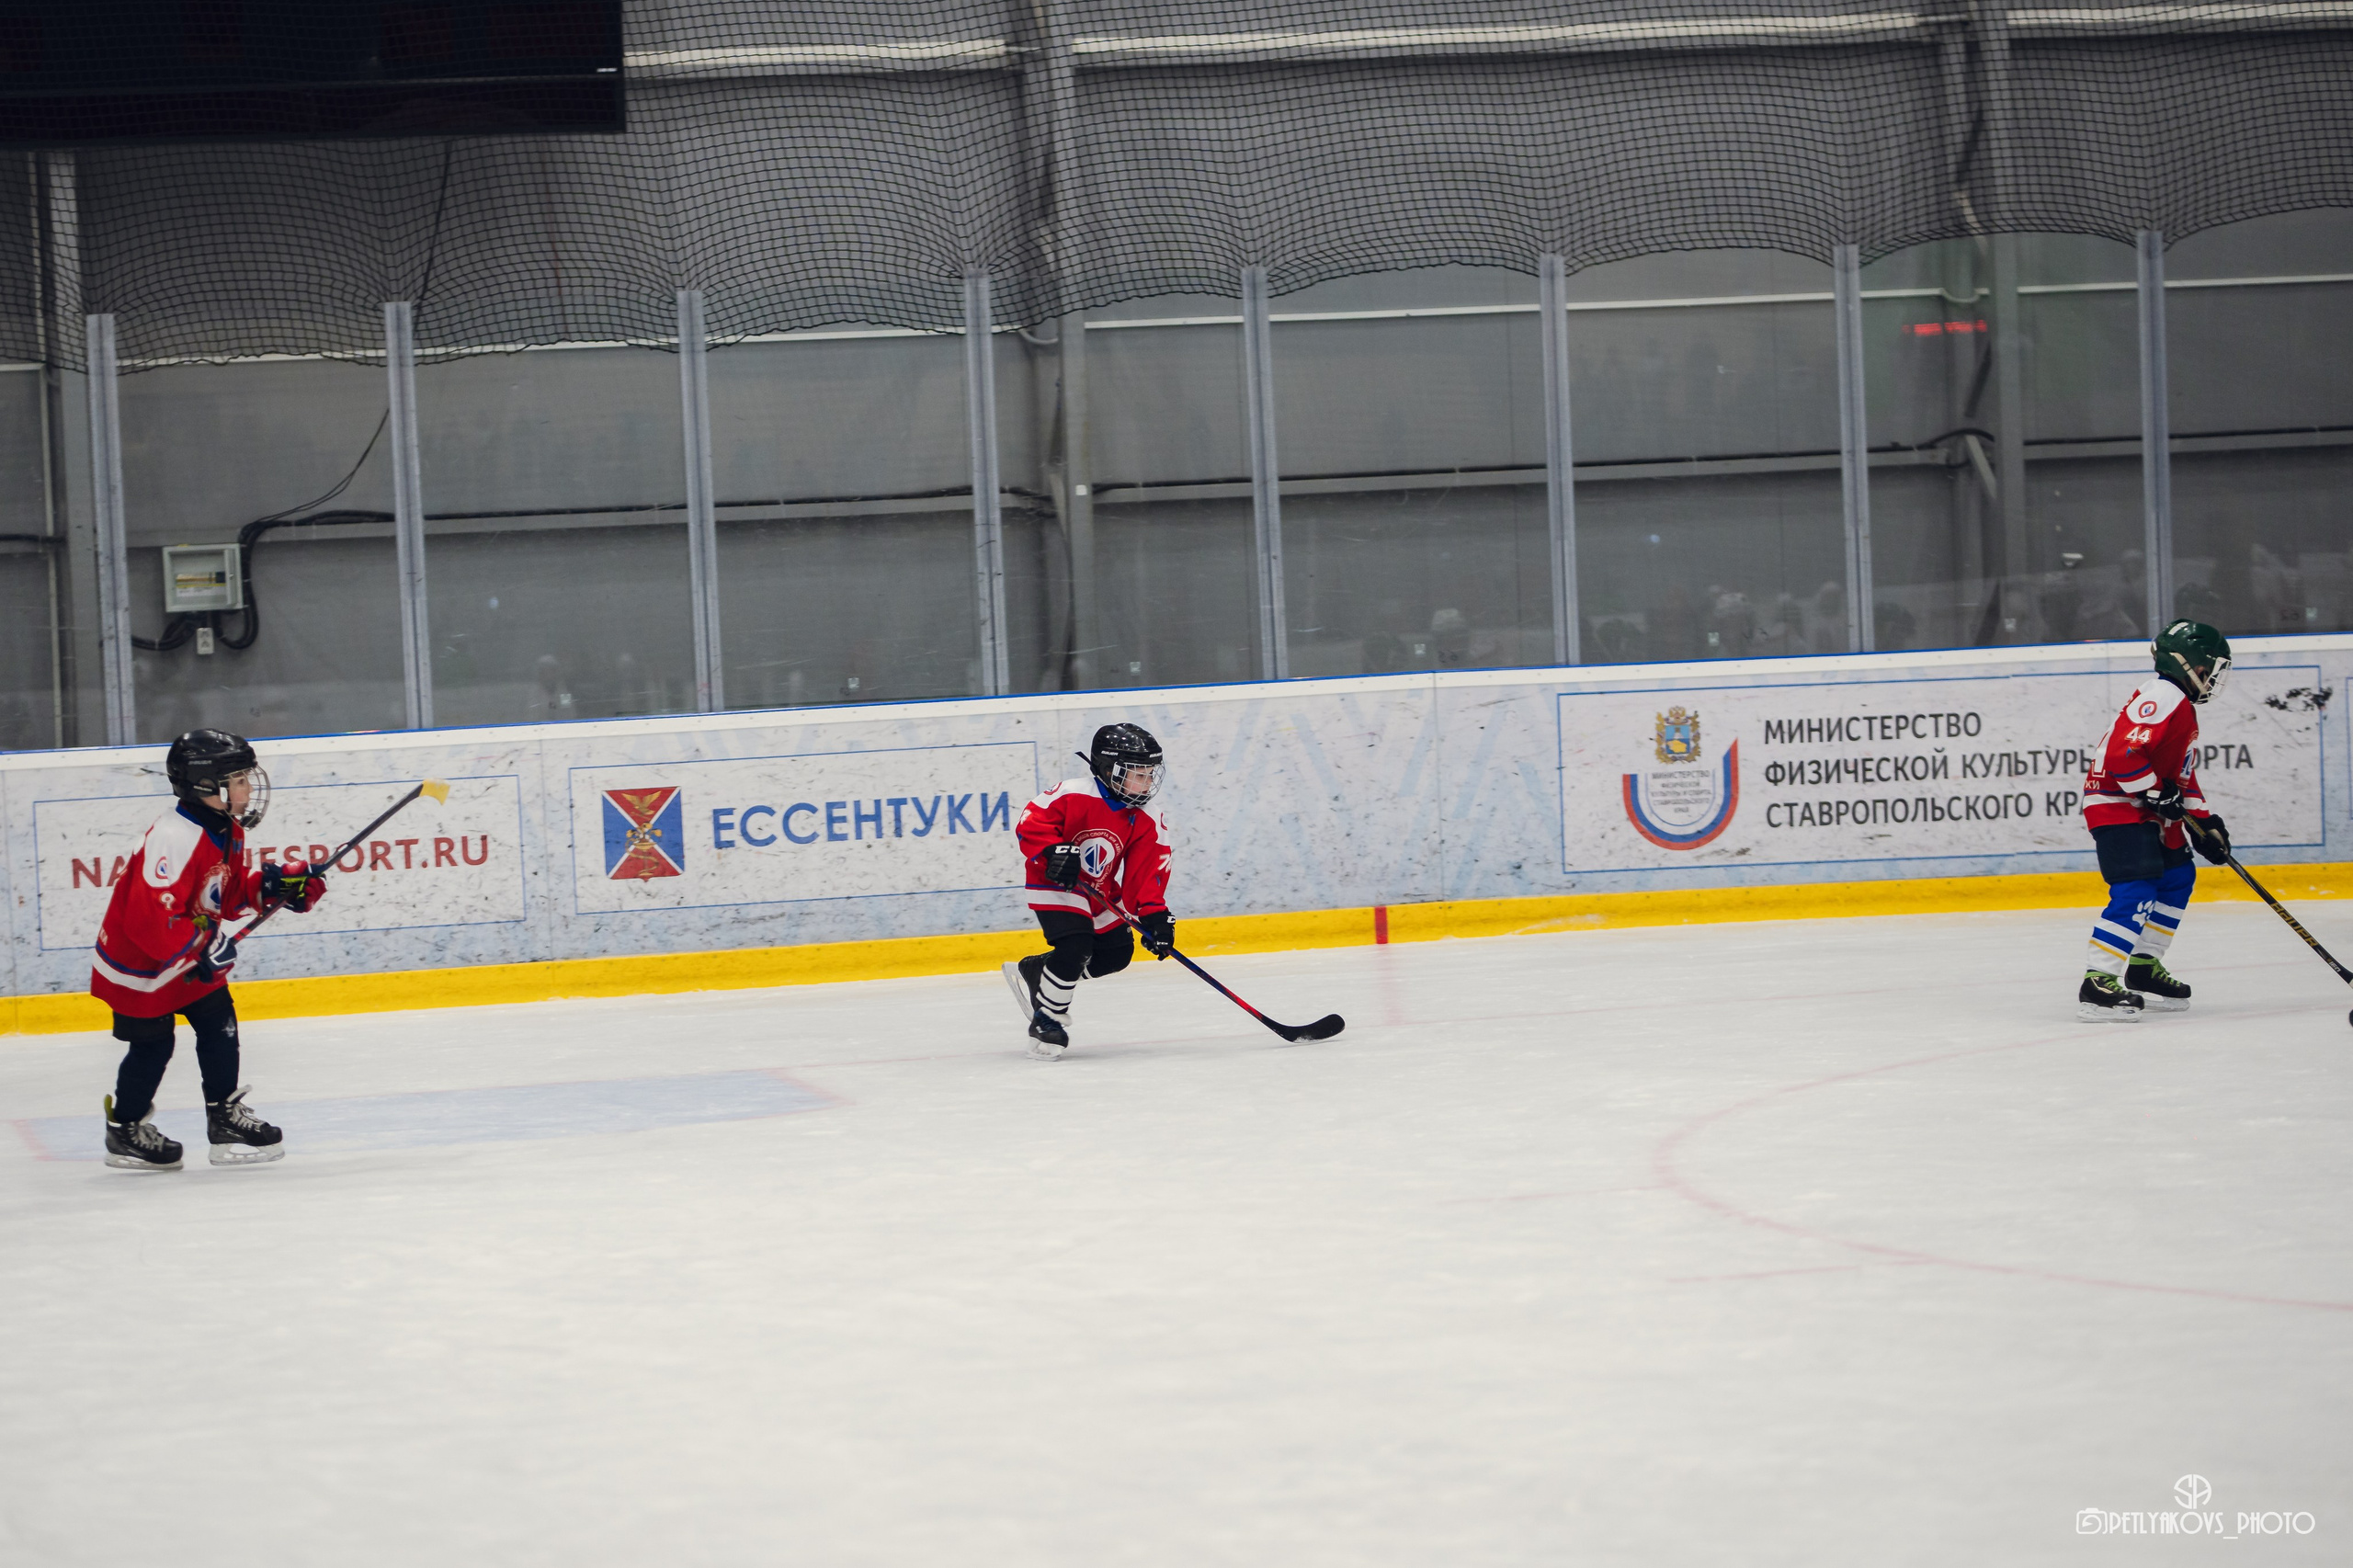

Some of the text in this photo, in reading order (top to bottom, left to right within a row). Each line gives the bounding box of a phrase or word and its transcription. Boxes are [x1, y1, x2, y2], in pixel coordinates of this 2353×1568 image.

[1764, 712, 1982, 744] МИНИСТЕРСТВО
[2125, 726, 2153, 744] 44
[1765, 747, 1949, 786] ФИЗИЧЕСКОЙ
[2193, 744, 2255, 769] ОРТА
[713, 790, 1010, 849] ЕССЕНТУКИ
[1766, 790, 2085, 828] СТАВРОПОЛЬСКОГО КР
[1054, 845, 1080, 854] CC
